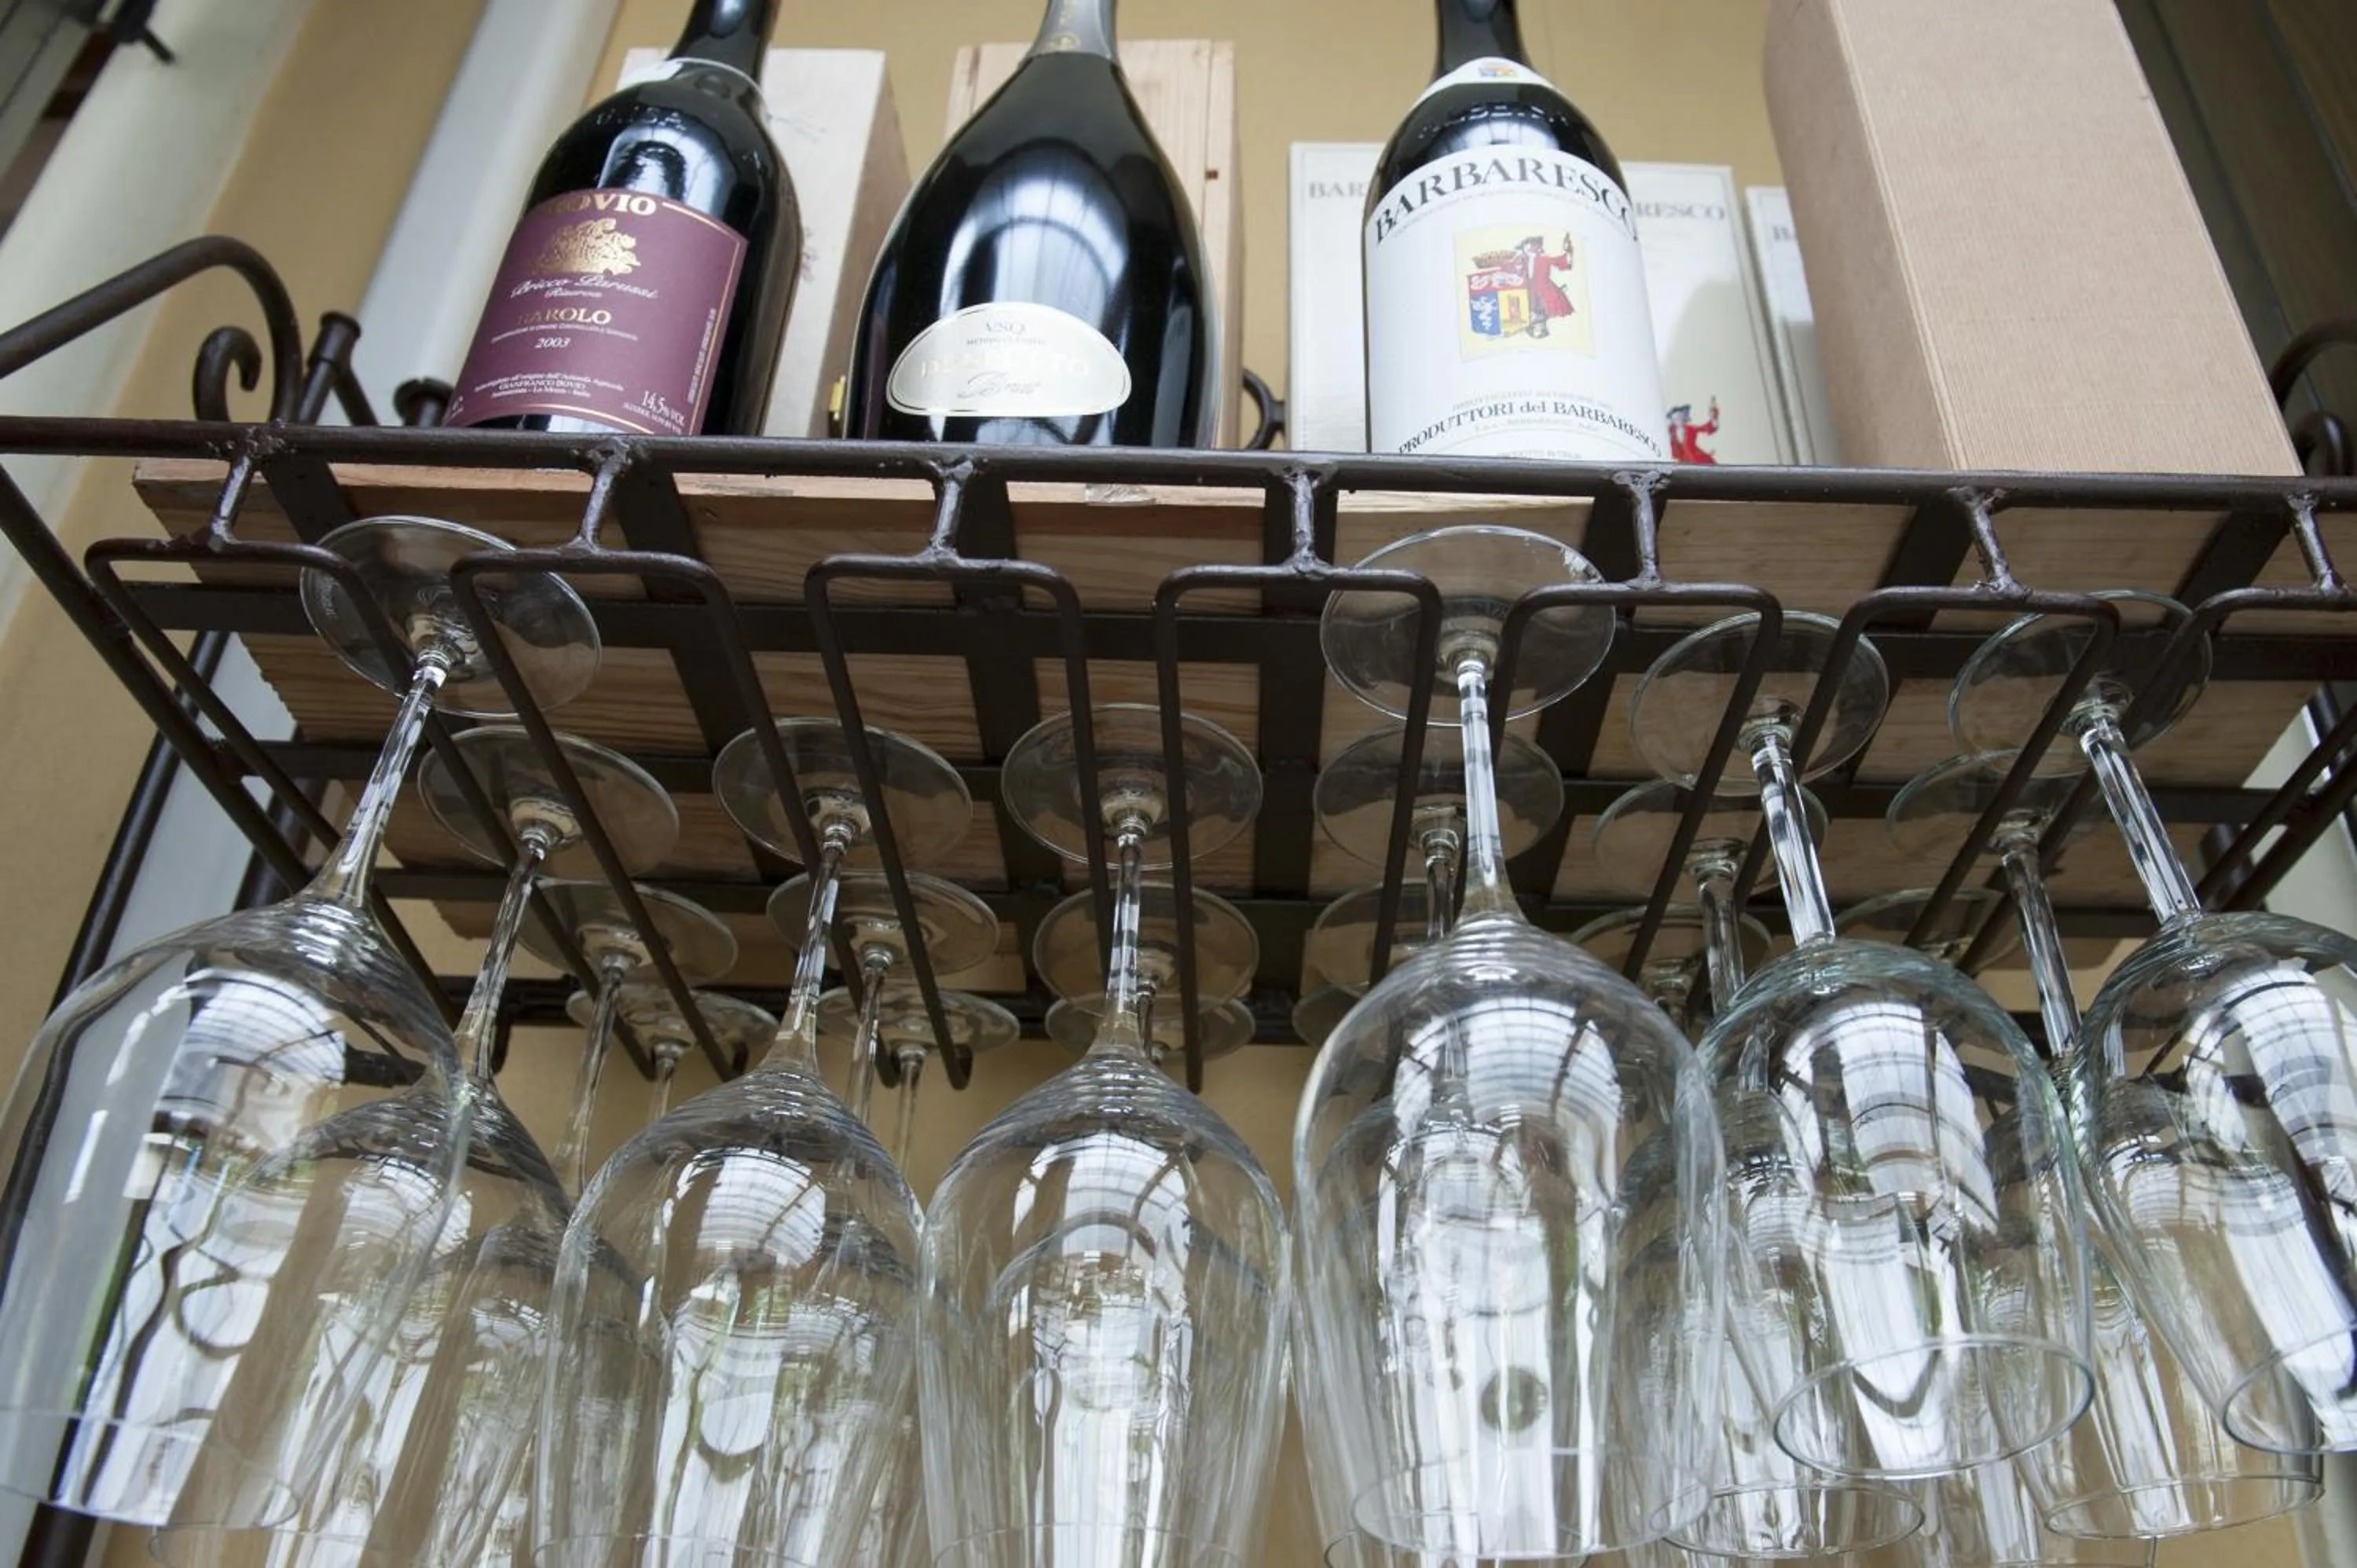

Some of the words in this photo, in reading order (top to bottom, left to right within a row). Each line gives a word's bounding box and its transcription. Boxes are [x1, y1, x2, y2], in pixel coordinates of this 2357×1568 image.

[534, 337, 571, 350] 2003
[1398, 401, 1513, 453] PRODUTTORI
[1519, 401, 1546, 414] del
